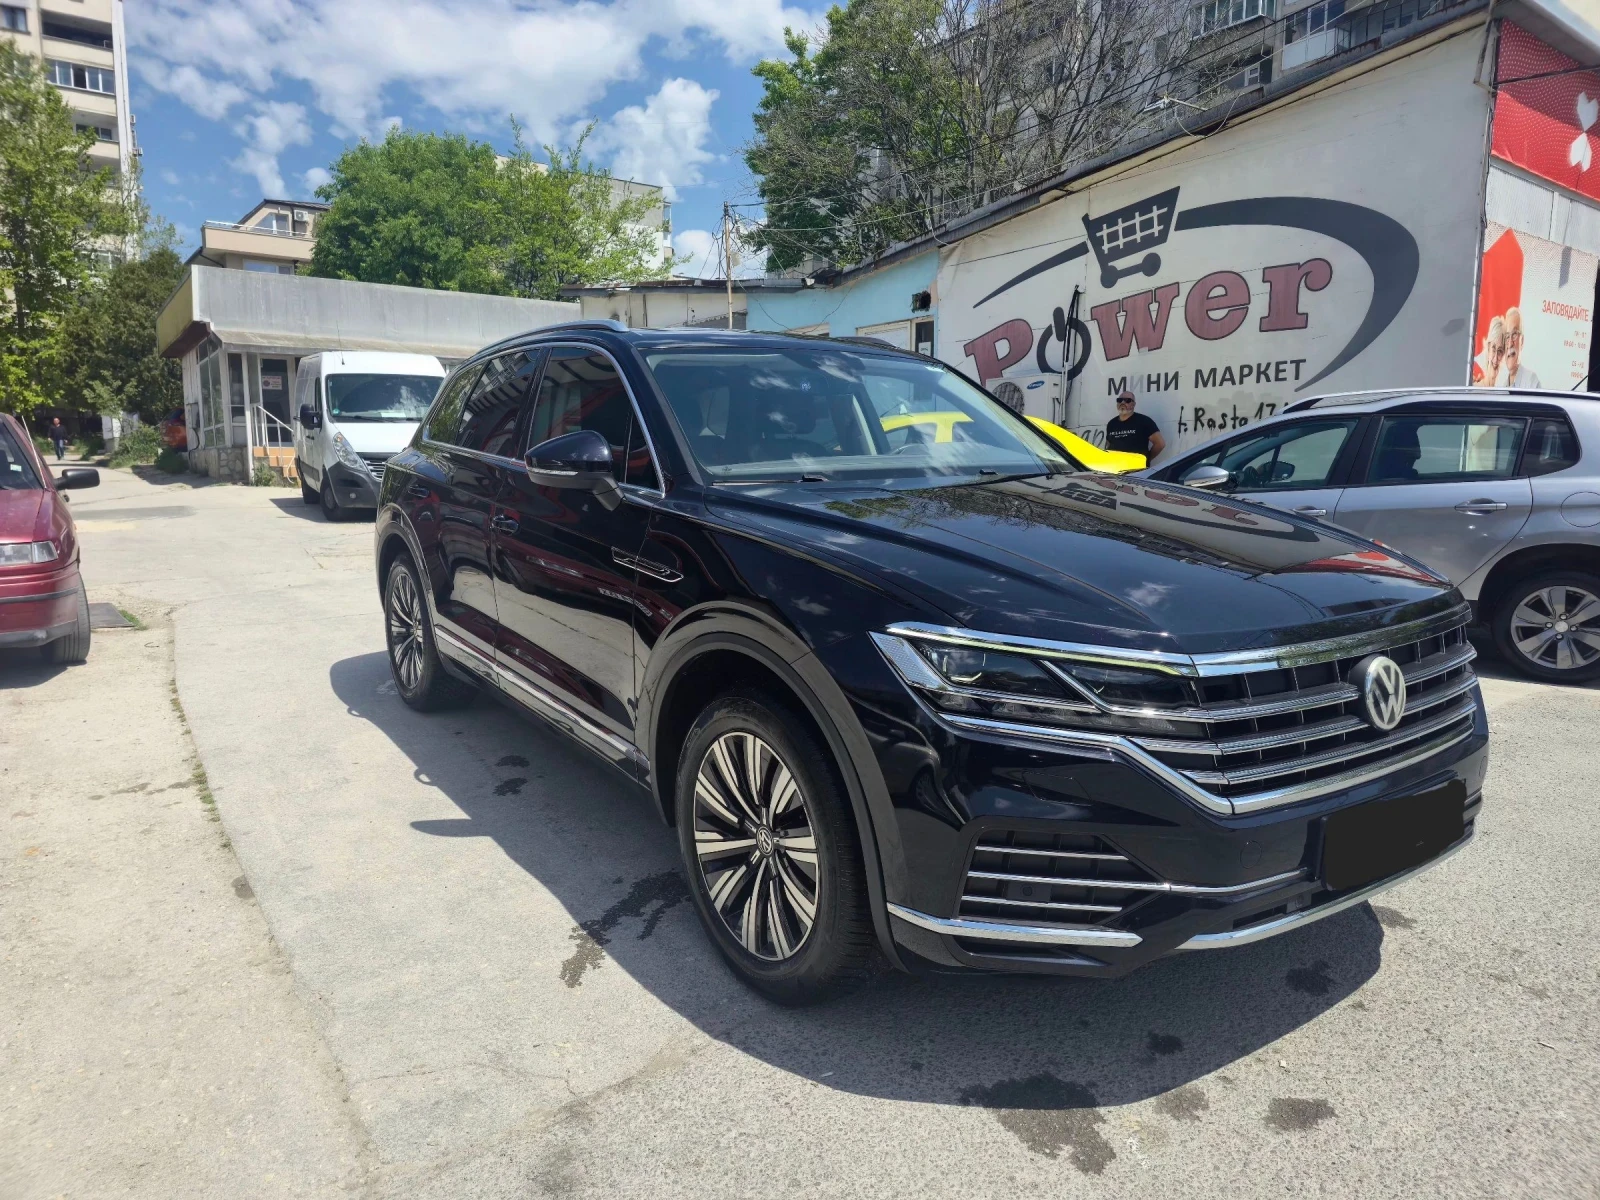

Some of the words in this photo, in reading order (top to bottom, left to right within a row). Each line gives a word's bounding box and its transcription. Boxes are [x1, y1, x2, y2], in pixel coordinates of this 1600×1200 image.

[964, 258, 1333, 387] Power
[1542, 299, 1589, 322] ЗАПОВЯДАЙТЕ
[1107, 371, 1180, 396] МИНИ
[1194, 358, 1307, 389] МАРКЕТ
[1194, 404, 1249, 432] Rasta
